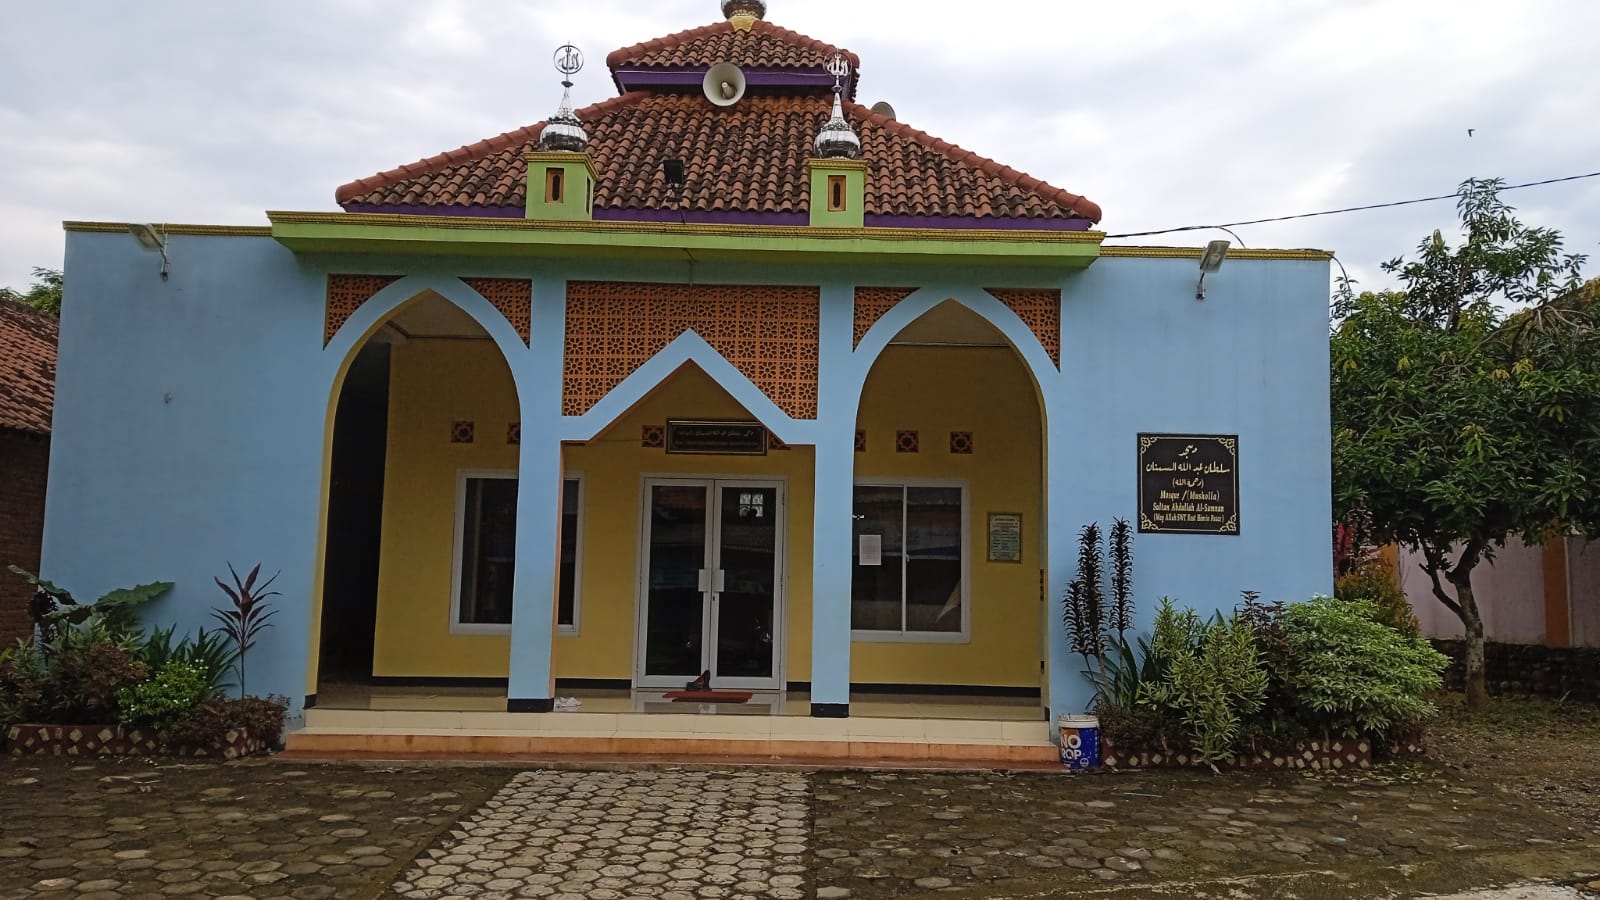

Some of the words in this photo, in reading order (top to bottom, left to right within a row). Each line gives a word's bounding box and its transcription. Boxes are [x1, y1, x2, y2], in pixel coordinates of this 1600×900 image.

[1177, 462, 1192, 472] الله
[1060, 734, 1081, 749] NO
[1061, 748, 1082, 760] ROP
